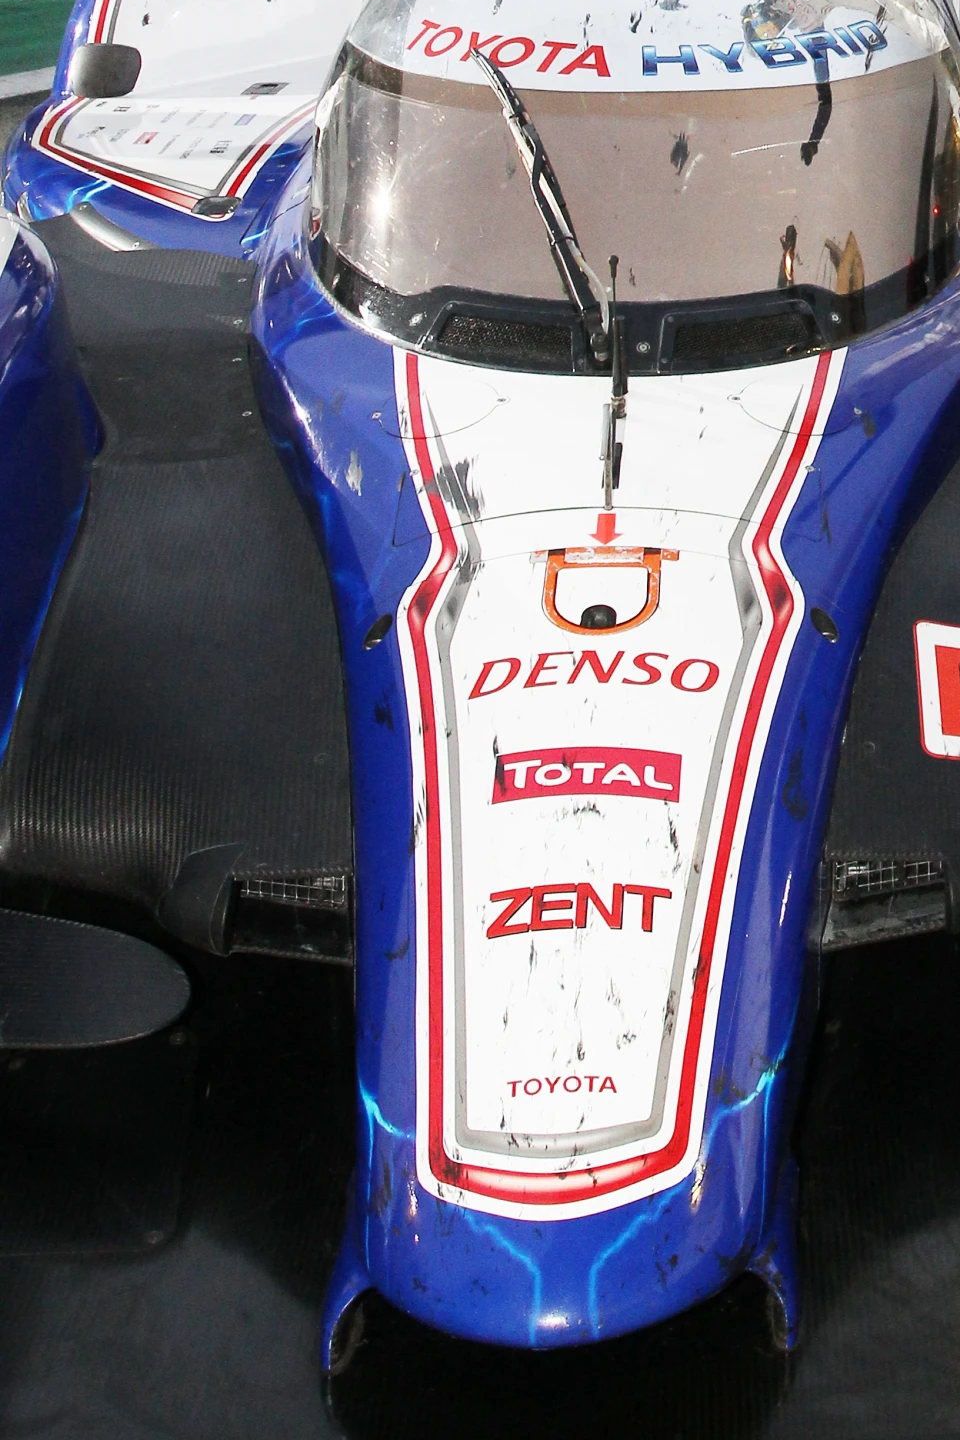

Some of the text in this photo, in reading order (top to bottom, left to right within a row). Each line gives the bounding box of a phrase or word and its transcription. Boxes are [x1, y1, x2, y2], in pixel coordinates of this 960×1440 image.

[406, 19, 888, 77] TOYOTA HYBRID
[467, 650, 720, 700] DENSO
[504, 758, 674, 792] TOTAL
[486, 882, 672, 940] ZENT
[506, 1075, 618, 1099] TOYOTA
